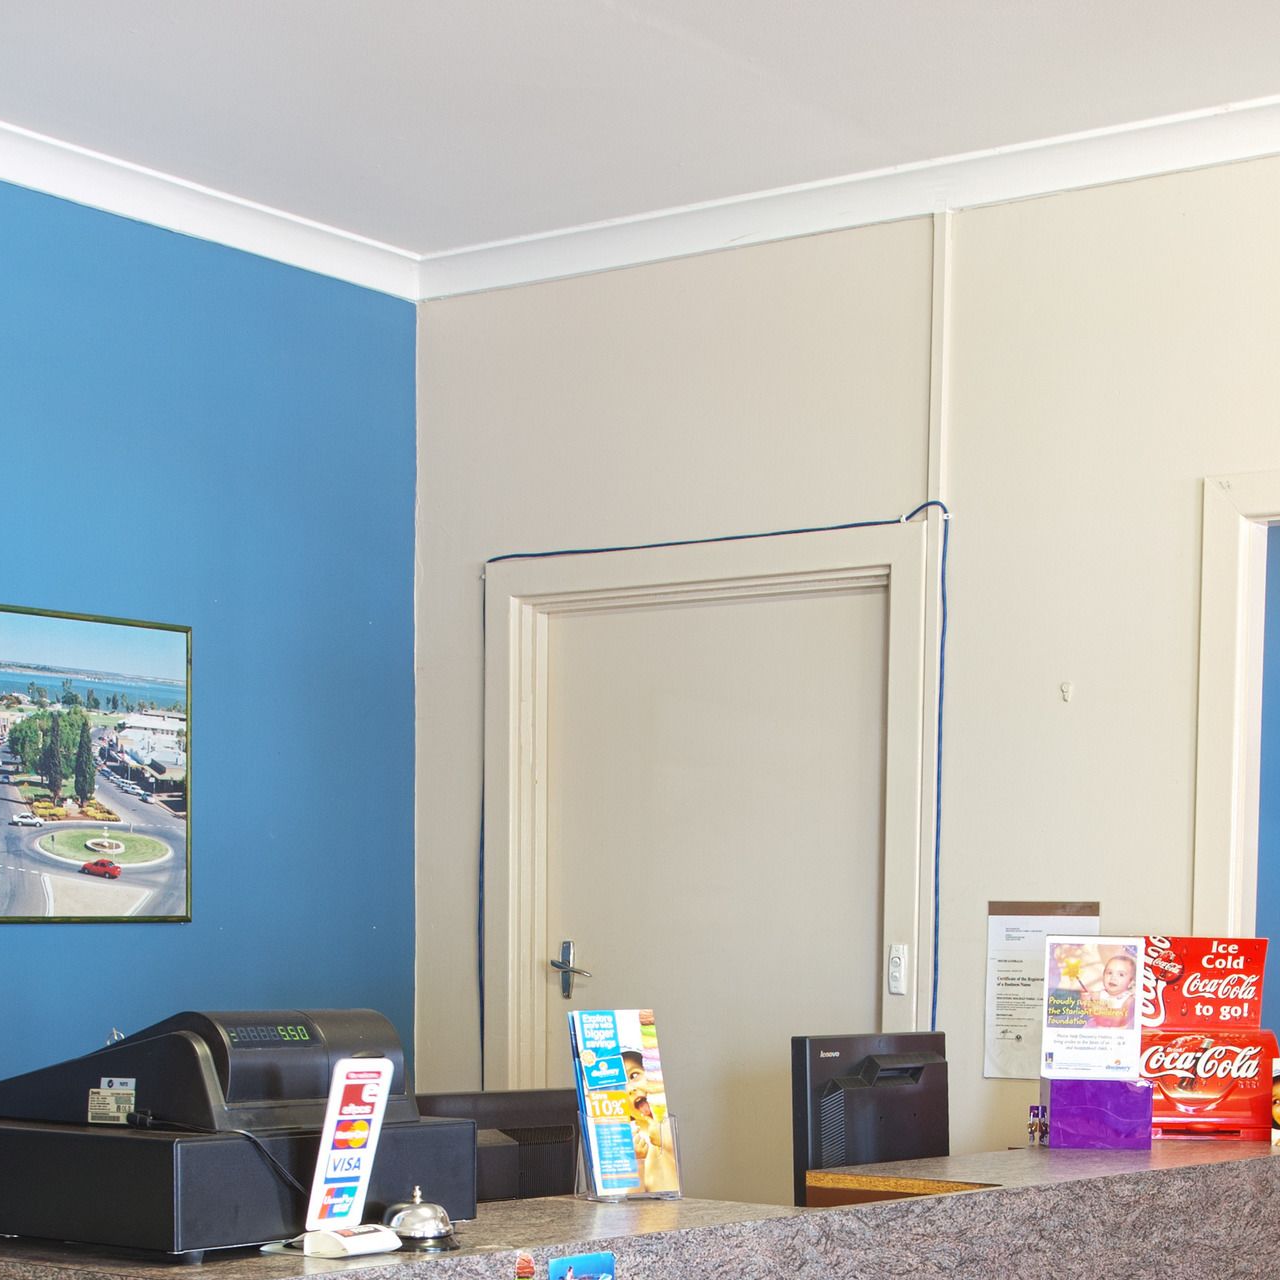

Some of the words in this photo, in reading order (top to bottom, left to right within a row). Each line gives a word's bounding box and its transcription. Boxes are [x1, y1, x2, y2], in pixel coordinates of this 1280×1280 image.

[1211, 941, 1238, 954] Ice
[1201, 956, 1245, 969] Cold
[1182, 972, 1259, 999] Coca-Cola
[1049, 997, 1075, 1008] Proudly
[1062, 1007, 1092, 1018] Starlight
[1195, 1003, 1214, 1016] to
[1220, 1003, 1249, 1020] go!
[582, 1014, 612, 1024] Explore
[1048, 1016, 1088, 1025] Foundation
[585, 1028, 614, 1040] bigger
[586, 1039, 616, 1049] savings
[1140, 1046, 1263, 1079] Coca-Cola
[333, 1157, 361, 1172] VISA
